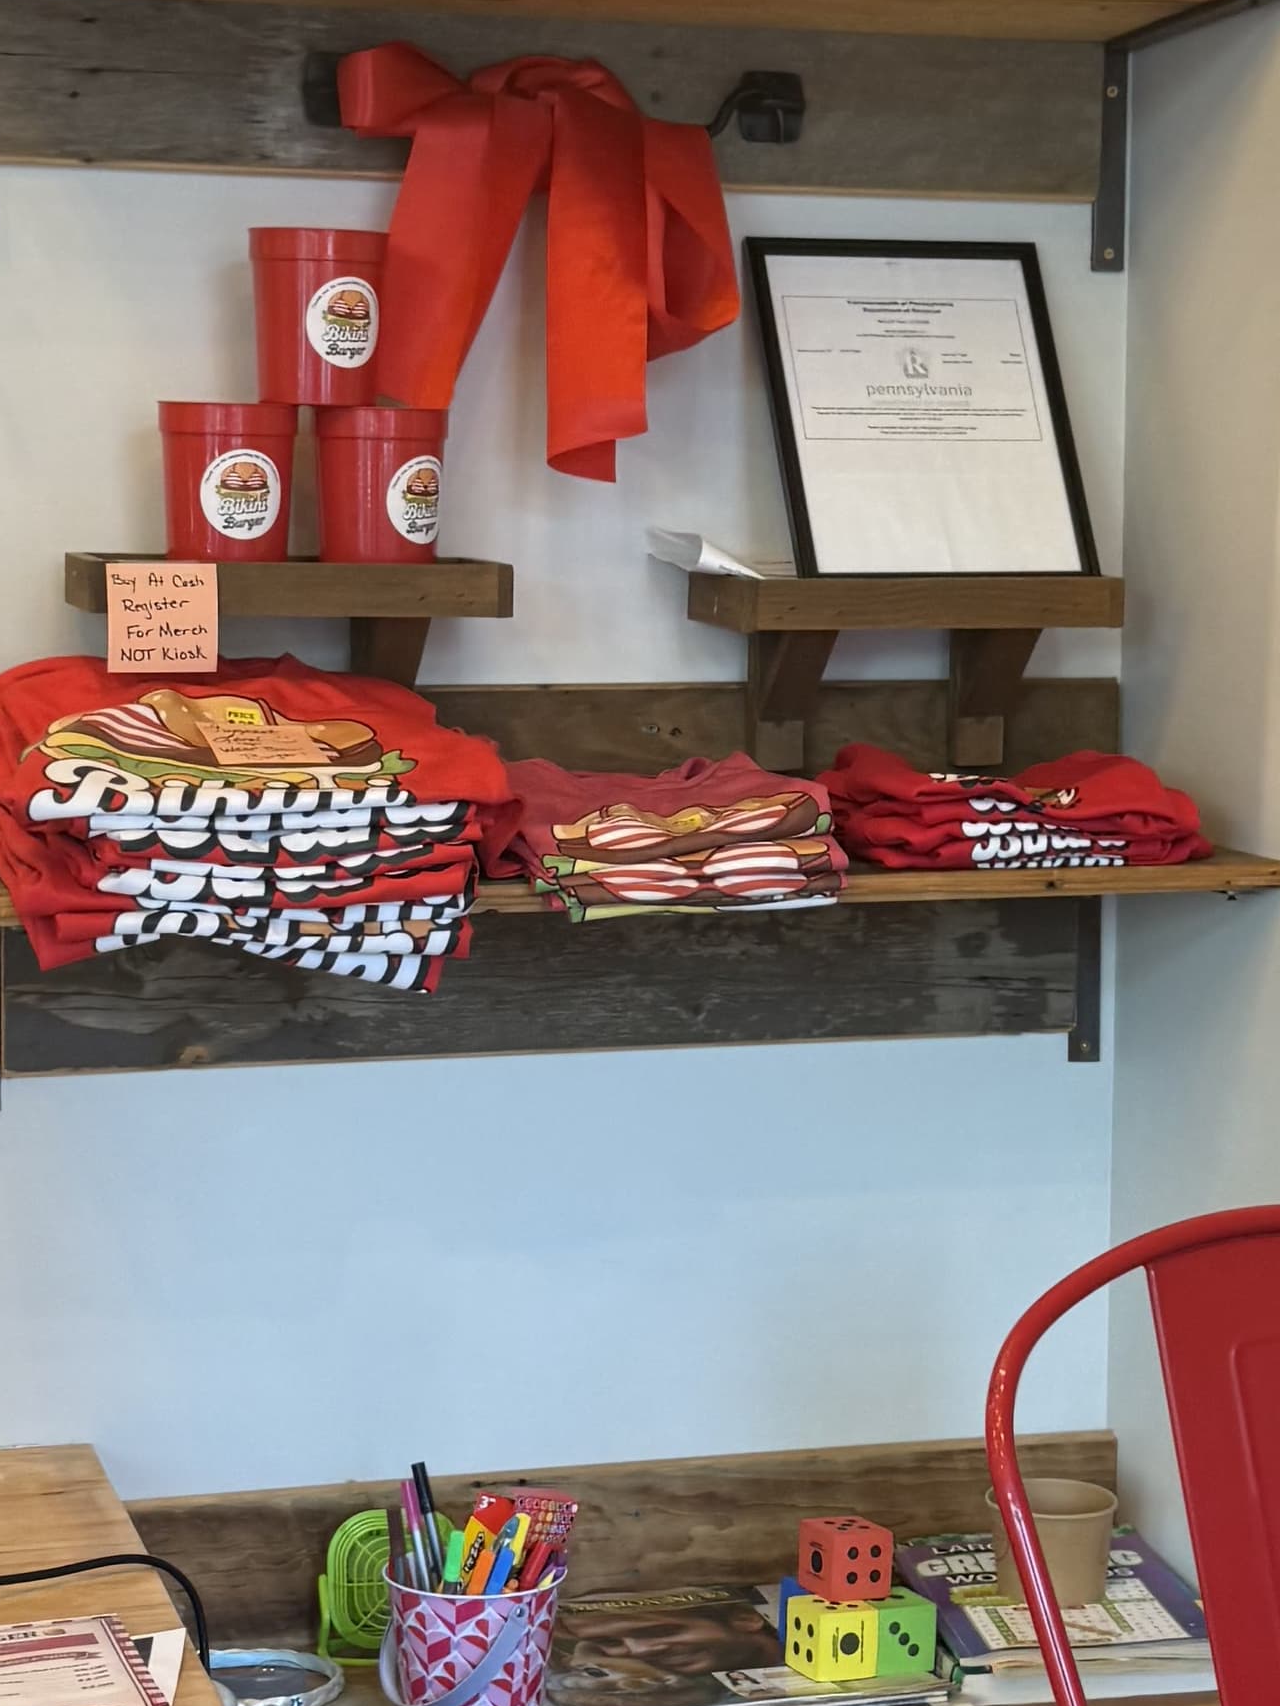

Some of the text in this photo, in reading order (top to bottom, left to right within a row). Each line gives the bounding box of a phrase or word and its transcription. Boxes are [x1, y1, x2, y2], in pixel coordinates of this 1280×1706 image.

[866, 383, 972, 398] pennsylvania
[111, 572, 205, 594] Buy At Cash
[121, 596, 191, 620] Register
[127, 621, 208, 639] For Merch
[120, 644, 208, 662] NOT Kiosk
